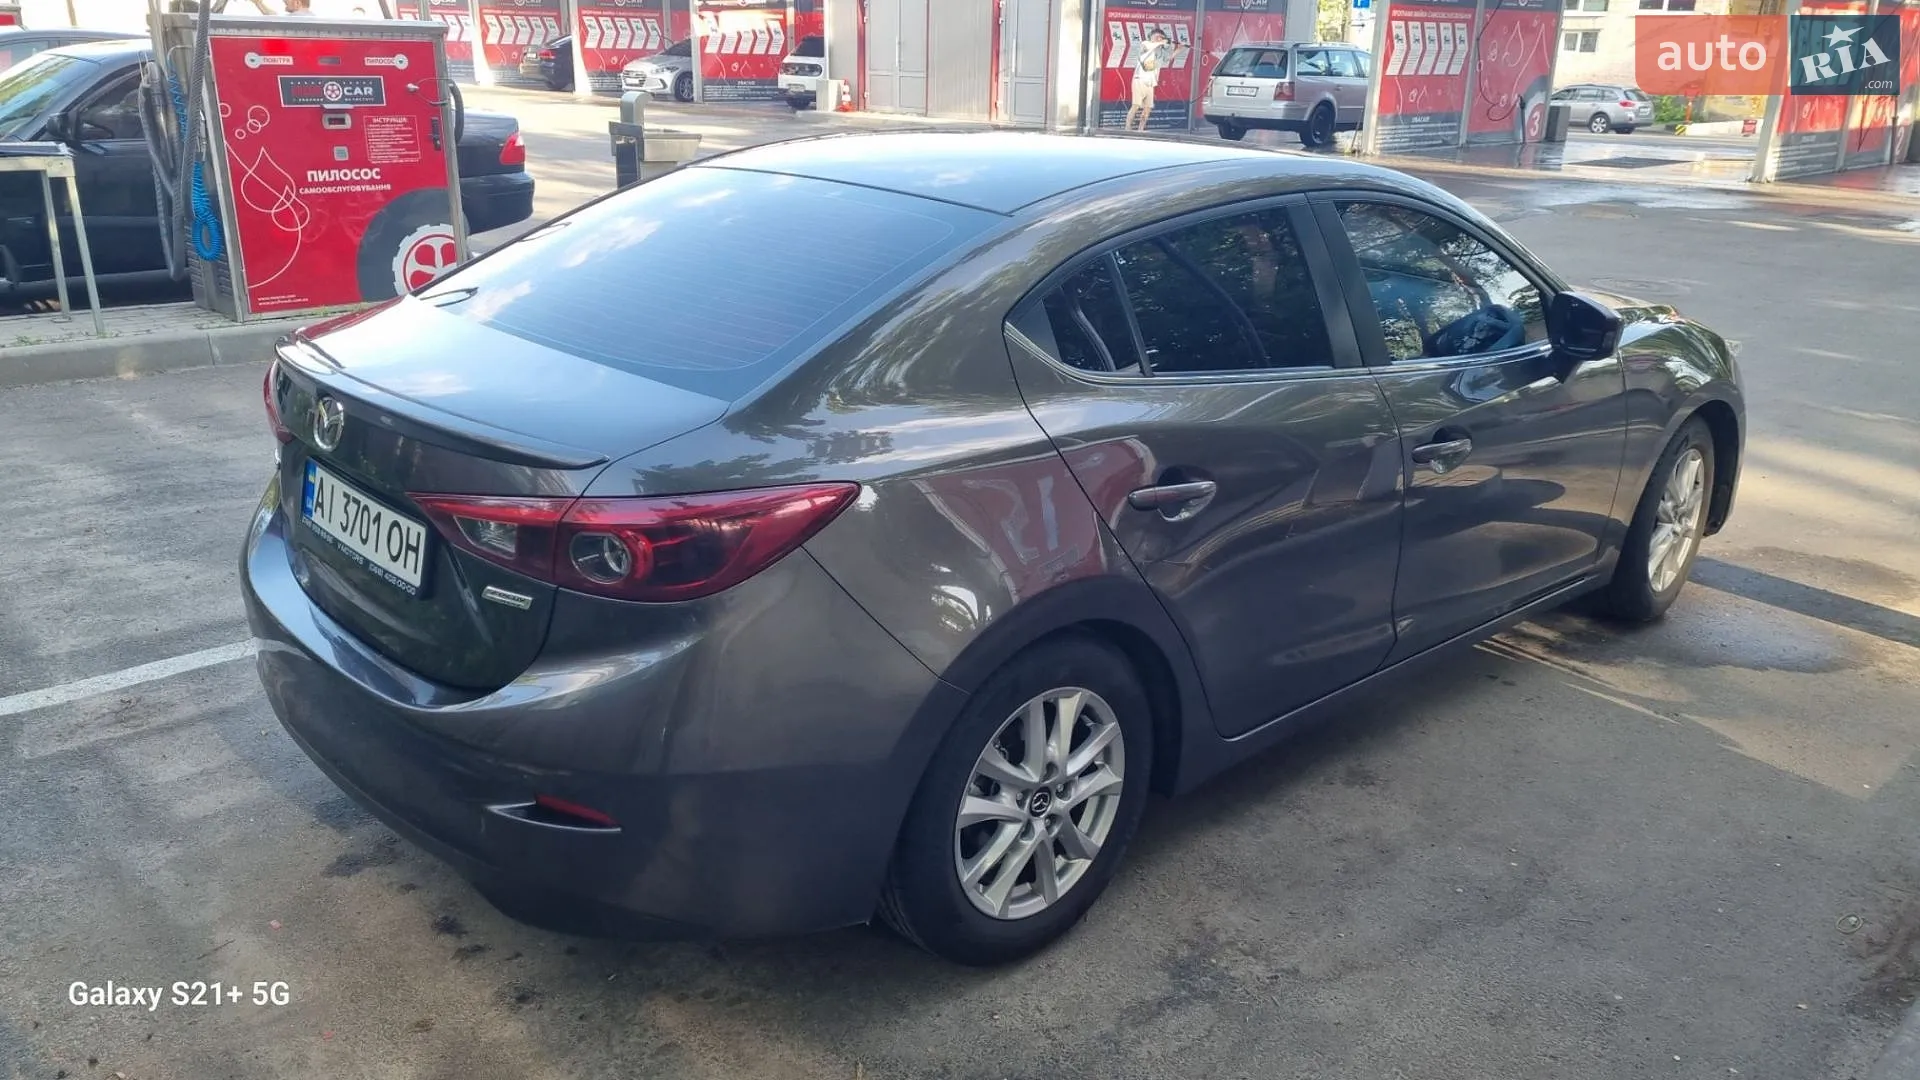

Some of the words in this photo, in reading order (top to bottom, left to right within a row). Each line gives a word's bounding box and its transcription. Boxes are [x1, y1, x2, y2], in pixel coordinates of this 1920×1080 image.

[344, 86, 373, 96] CAR
[1530, 111, 1541, 137] 3
[307, 168, 381, 182] ПИЛОСОС
[299, 184, 392, 195] САМООБСЛУГОВУВАННЯ
[314, 476, 335, 525] AI
[340, 491, 382, 554] 3701
[387, 519, 421, 575] OH
